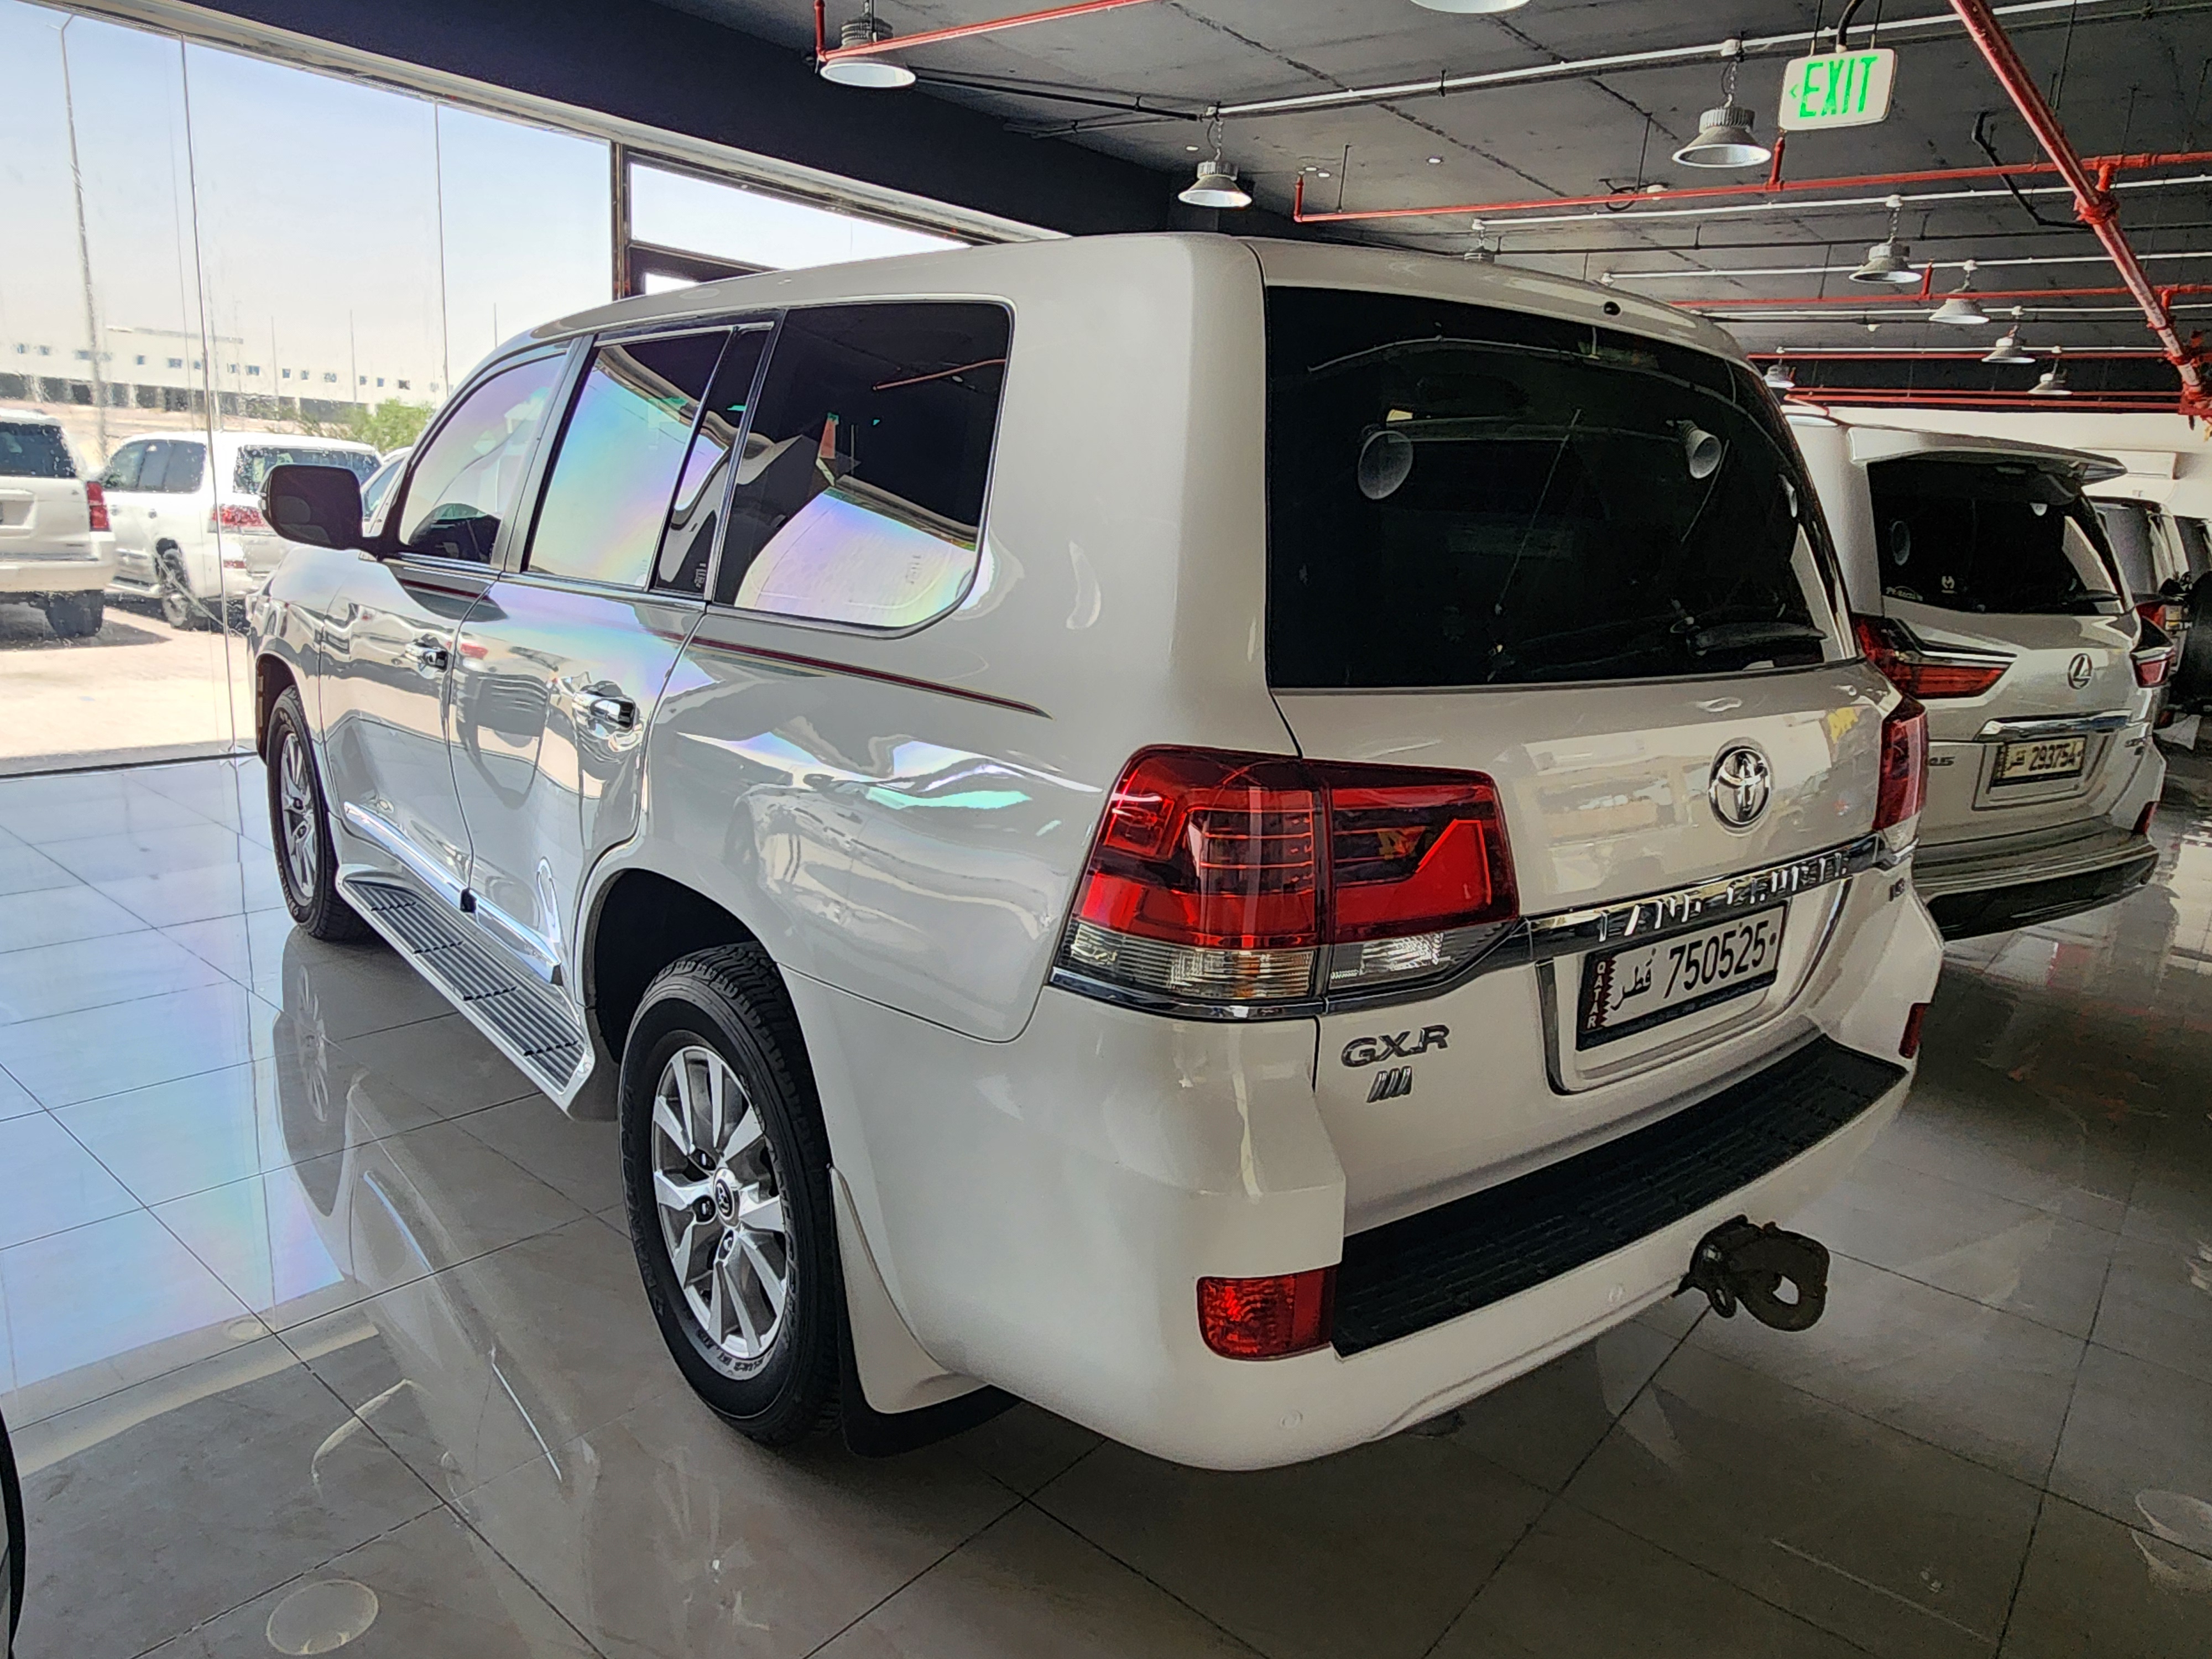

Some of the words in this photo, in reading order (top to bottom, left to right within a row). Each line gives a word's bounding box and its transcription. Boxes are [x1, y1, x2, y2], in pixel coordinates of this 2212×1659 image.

[1799, 56, 1878, 118] EXIT
[1587, 961, 1607, 1029] QATAR
[1610, 955, 1653, 1011] قطر
[1663, 920, 1769, 999] 750525
[1341, 1024, 1450, 1067] GXR
